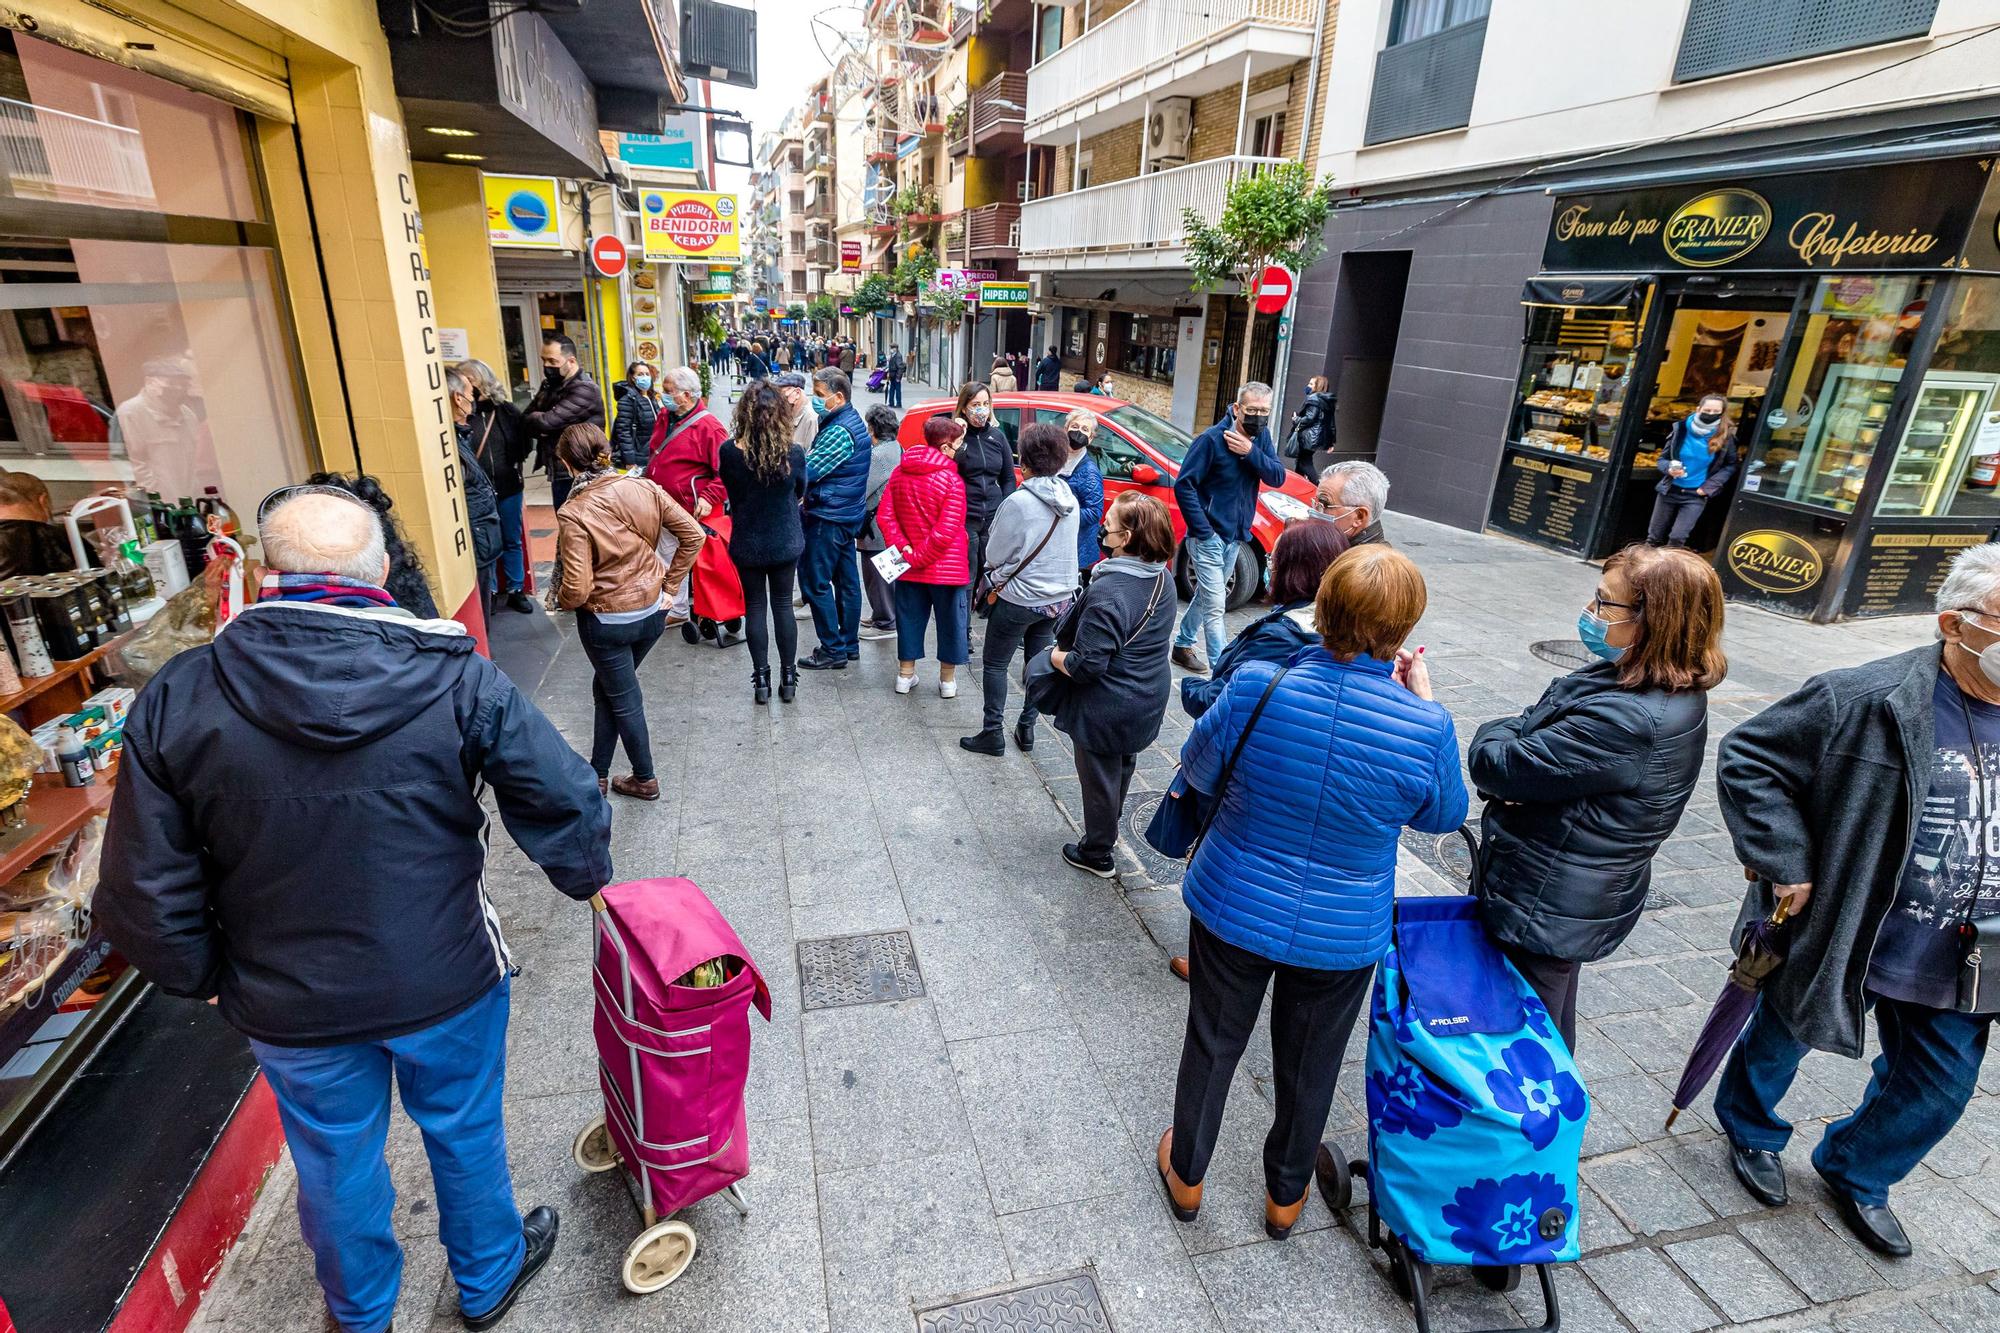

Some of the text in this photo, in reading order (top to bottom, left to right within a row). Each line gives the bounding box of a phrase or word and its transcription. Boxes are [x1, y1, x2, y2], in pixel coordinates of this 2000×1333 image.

[670, 204, 713, 219] PIZZERIA
[650, 218, 732, 233] BENIDORM
[1607, 210, 1632, 236] de
[1628, 220, 1661, 246] pa
[1669, 214, 1763, 241] GRANIER
[673, 234, 715, 247] KEBAB
[1788, 212, 1939, 267] Cafeteria
[966, 272, 995, 280] PRECIO
[984, 289, 1028, 302] HIPER 0,60
[397, 172, 468, 558] CHARCUTERIA
[1733, 544, 1816, 581] GRANIER
[1438, 1015, 1470, 1026] ROLSER
